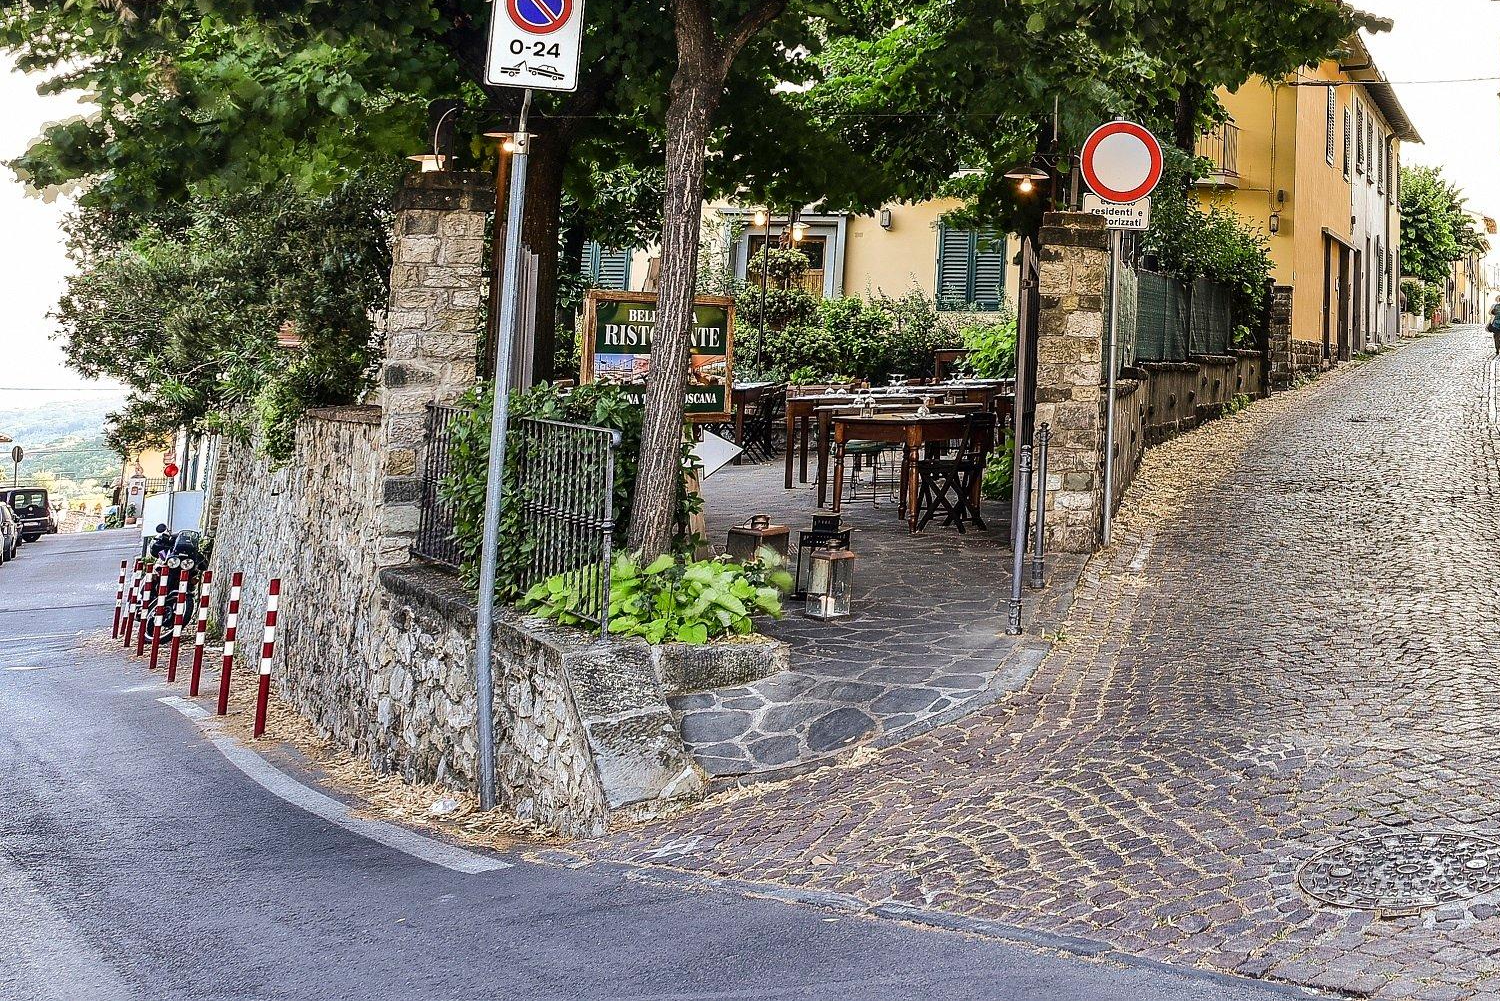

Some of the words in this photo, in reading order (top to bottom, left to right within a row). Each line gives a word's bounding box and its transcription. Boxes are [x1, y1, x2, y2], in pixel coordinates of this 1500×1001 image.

[509, 39, 561, 59] 0-24
[1091, 207, 1133, 216] residenti
[1107, 217, 1142, 227] orizzati
